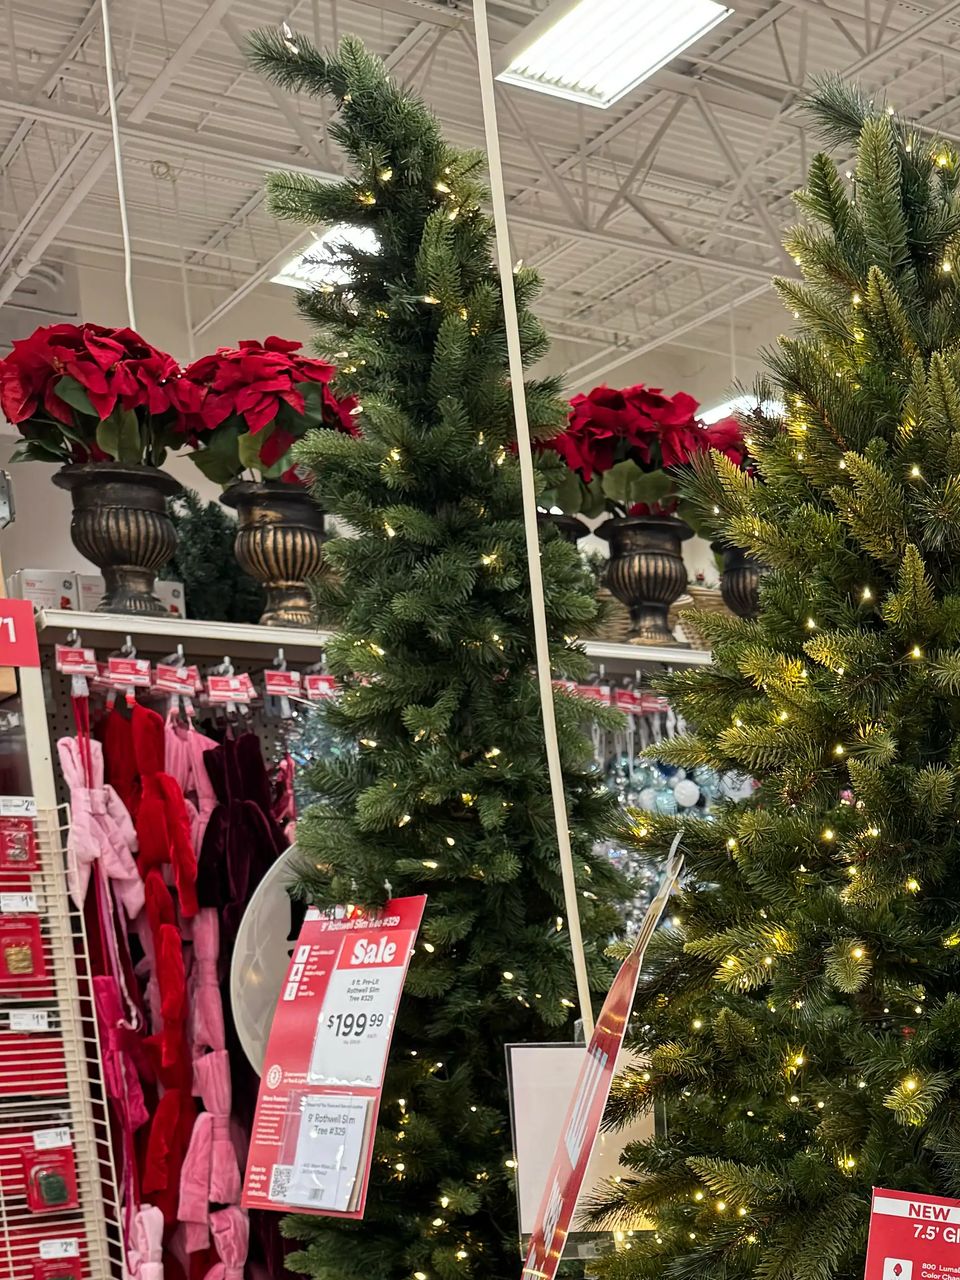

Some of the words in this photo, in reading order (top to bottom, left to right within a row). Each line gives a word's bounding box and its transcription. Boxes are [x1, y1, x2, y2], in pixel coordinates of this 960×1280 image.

[350, 936, 396, 965] Sale
[908, 1203, 951, 1221] NEW
[913, 1224, 939, 1240] 7.5'
[921, 1270, 941, 1280] Color
